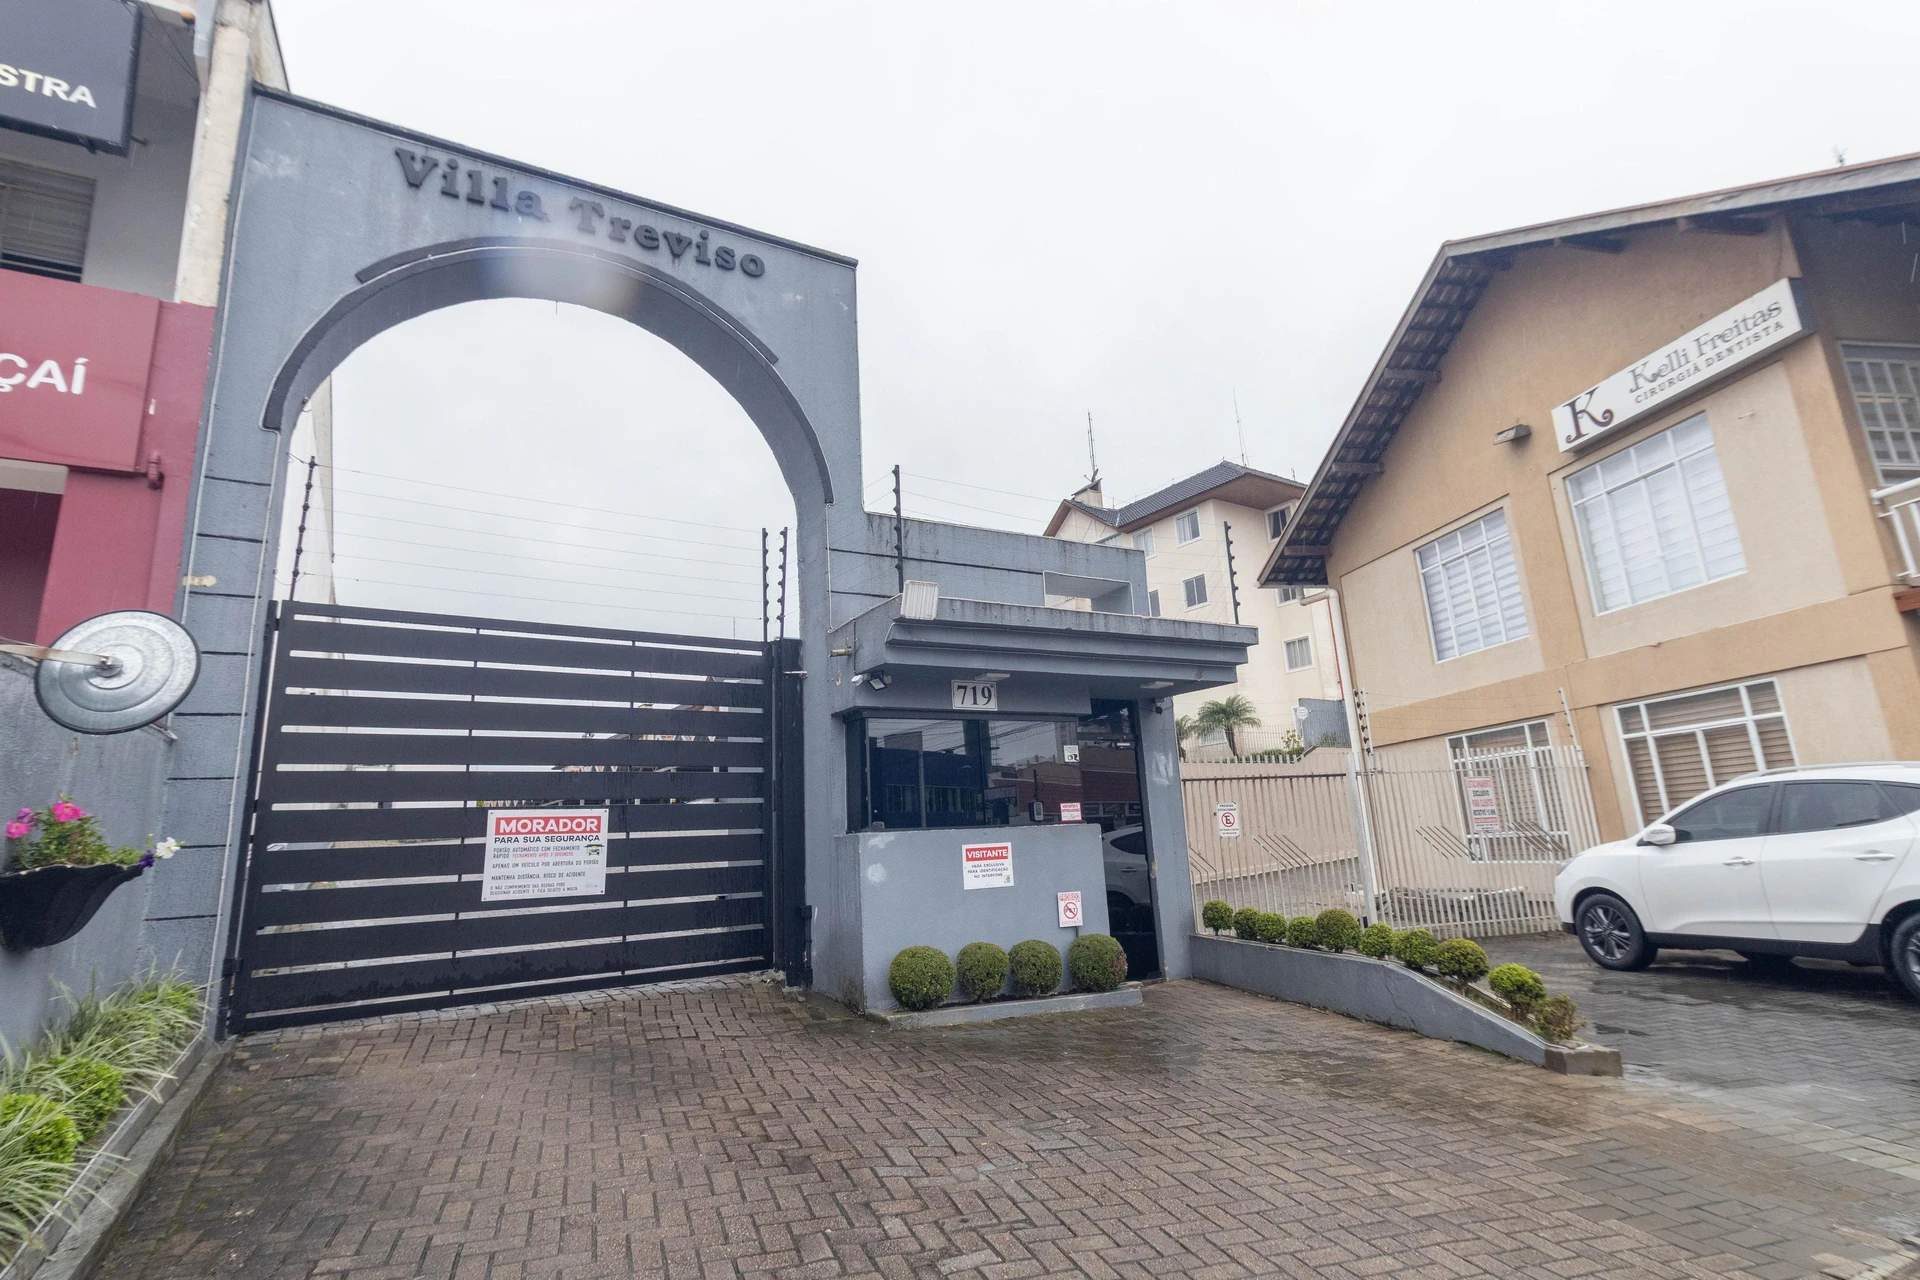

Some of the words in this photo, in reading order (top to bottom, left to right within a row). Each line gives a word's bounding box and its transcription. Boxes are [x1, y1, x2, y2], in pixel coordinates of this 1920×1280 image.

[395, 147, 551, 222] Villa
[569, 196, 765, 277] Treviso
[1628, 348, 1692, 394] Kelli
[1693, 301, 1783, 358] Freitas
[1634, 362, 1702, 404] CIRURGIÃ
[1705, 320, 1784, 368] DENTISTA
[1562, 386, 1614, 444] K
[956, 685, 992, 706] 719
[494, 836, 519, 844] PARA
[544, 834, 600, 843] SEGURANÇA
[499, 818, 598, 833] MORADOR
[967, 849, 1008, 859] VISITANTE
